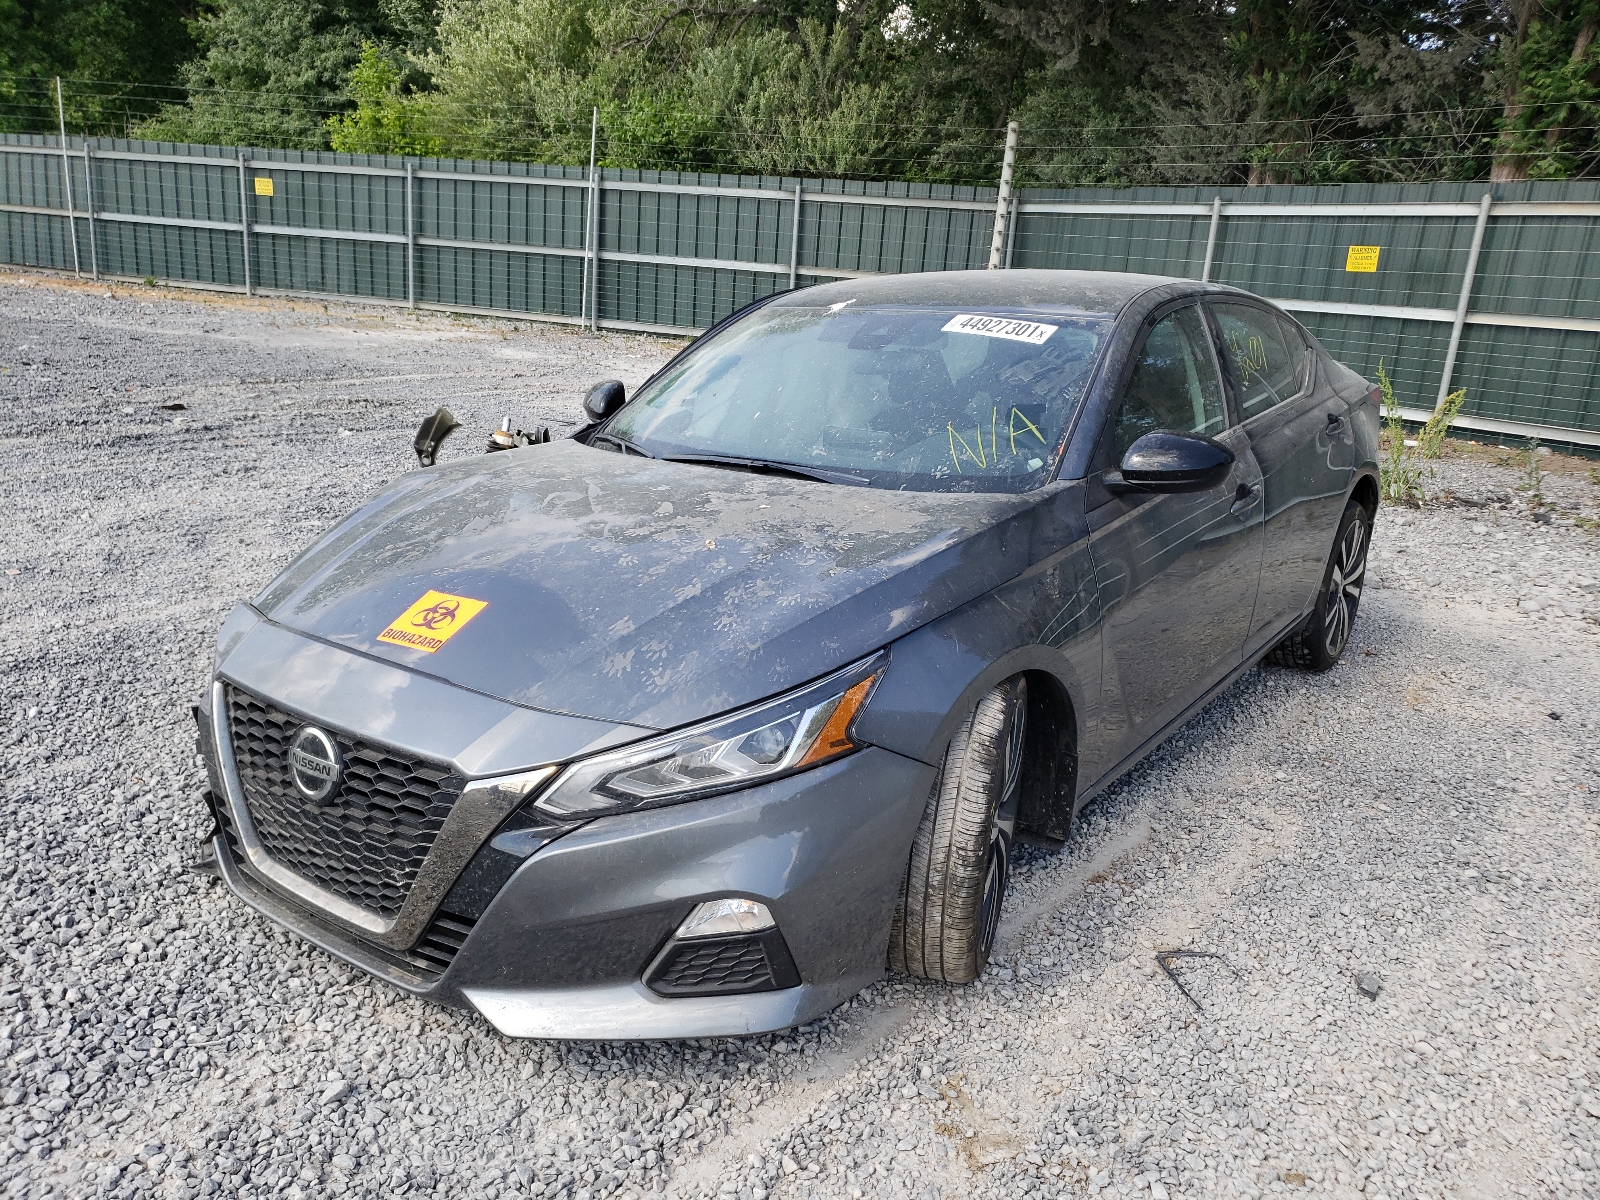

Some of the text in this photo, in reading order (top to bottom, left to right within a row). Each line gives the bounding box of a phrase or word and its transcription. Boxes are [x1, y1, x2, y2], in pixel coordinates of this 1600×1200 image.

[946, 406, 1047, 474] N/A
[381, 628, 443, 649] BIOHAZARD
[292, 752, 331, 777] NISSAN
